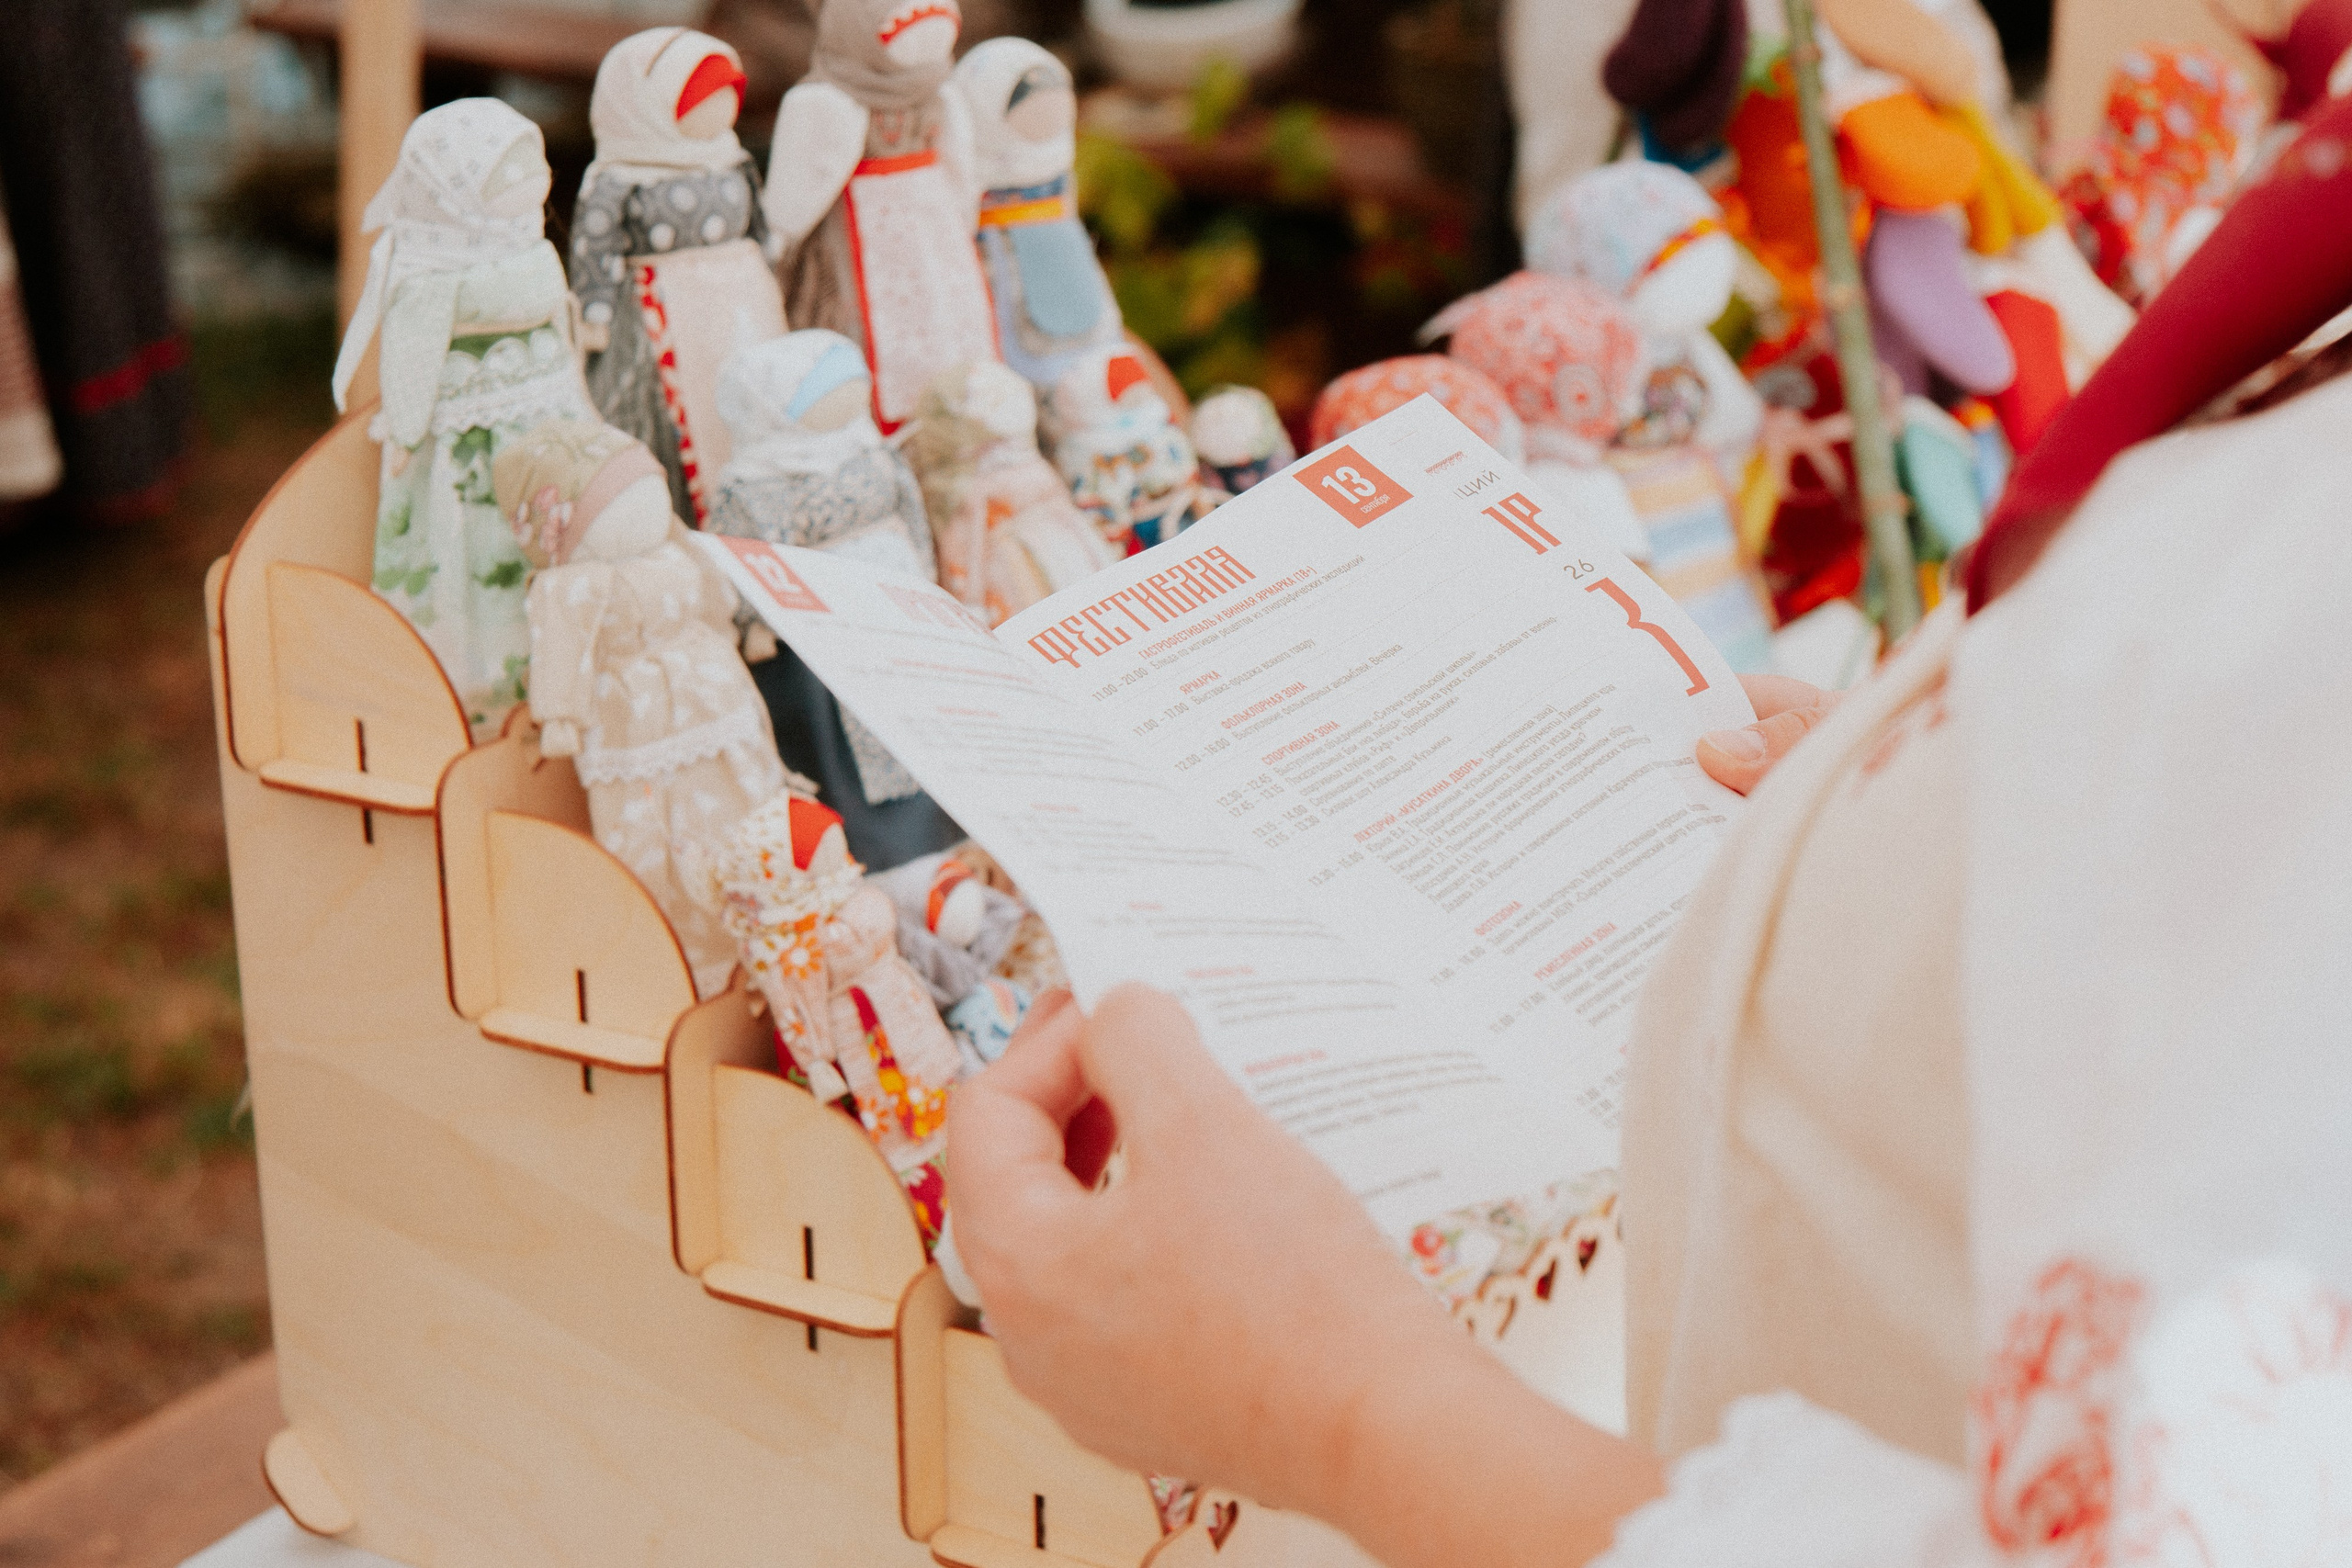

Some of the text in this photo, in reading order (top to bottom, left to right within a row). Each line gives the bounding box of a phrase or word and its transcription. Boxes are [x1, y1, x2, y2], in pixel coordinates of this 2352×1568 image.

[1322, 468, 1378, 504] 13
[1359, 493, 1390, 513] сентября
[1453, 469, 1501, 500] ЦИЙ
[1564, 558, 1595, 580] 26
[1092, 683, 1117, 701] 11.00
[1122, 668, 1149, 685] 20.00
[1151, 652, 1179, 670] Блюда
[1188, 634, 1218, 652] мотивам
[1218, 615, 1252, 637] рецептов
[1261, 578, 1322, 615] этнографических
[1320, 554, 1364, 581] экспедиций
[1139, 616, 1216, 660] ГАСТРОФЕСТИВАЛЬ
[1221, 595, 1257, 618] ВИННАЯ
[1254, 576, 1295, 601] ЯРМАРКА
[1293, 565, 1317, 581] (18+)
[1133, 718, 1159, 736] 11.00
[1164, 702, 1189, 718] 17.00
[1191, 665, 1261, 704] Выставка-продажа
[1261, 651, 1290, 669] всякого
[1290, 638, 1315, 655] товару
[1179, 670, 1219, 694] ЯРМАРКА
[1219, 681, 1306, 729] ФОЛЬКЛОРНАЯ ЗОНА
[1174, 753, 1200, 772] 12.00
[1204, 738, 1230, 754] 16.00
[1232, 710, 1282, 739] Выступление
[1281, 684, 1331, 716] фольклорных
[1285, 750, 1343, 786] Показательные
[1400, 696, 1429, 718] борьба
[1428, 690, 1439, 700] на
[1462, 652, 1495, 677] силовые
[1493, 635, 1521, 656] забавы
[1521, 630, 1530, 638] от
[1261, 719, 1339, 766] СПОРТИВНАЯ ЗОНА
[1272, 744, 1324, 775] Выступление
[1322, 717, 1371, 750] объединения
[1351, 811, 1396, 843] ЛЕКТОРИЙ
[1394, 777, 1451, 818] «МУСАТКИНА
[1447, 754, 1484, 783] ДВОРА»
[1473, 899, 1522, 936] ФОТОЗОНА
[1592, 920, 1616, 941] ЗОНА
